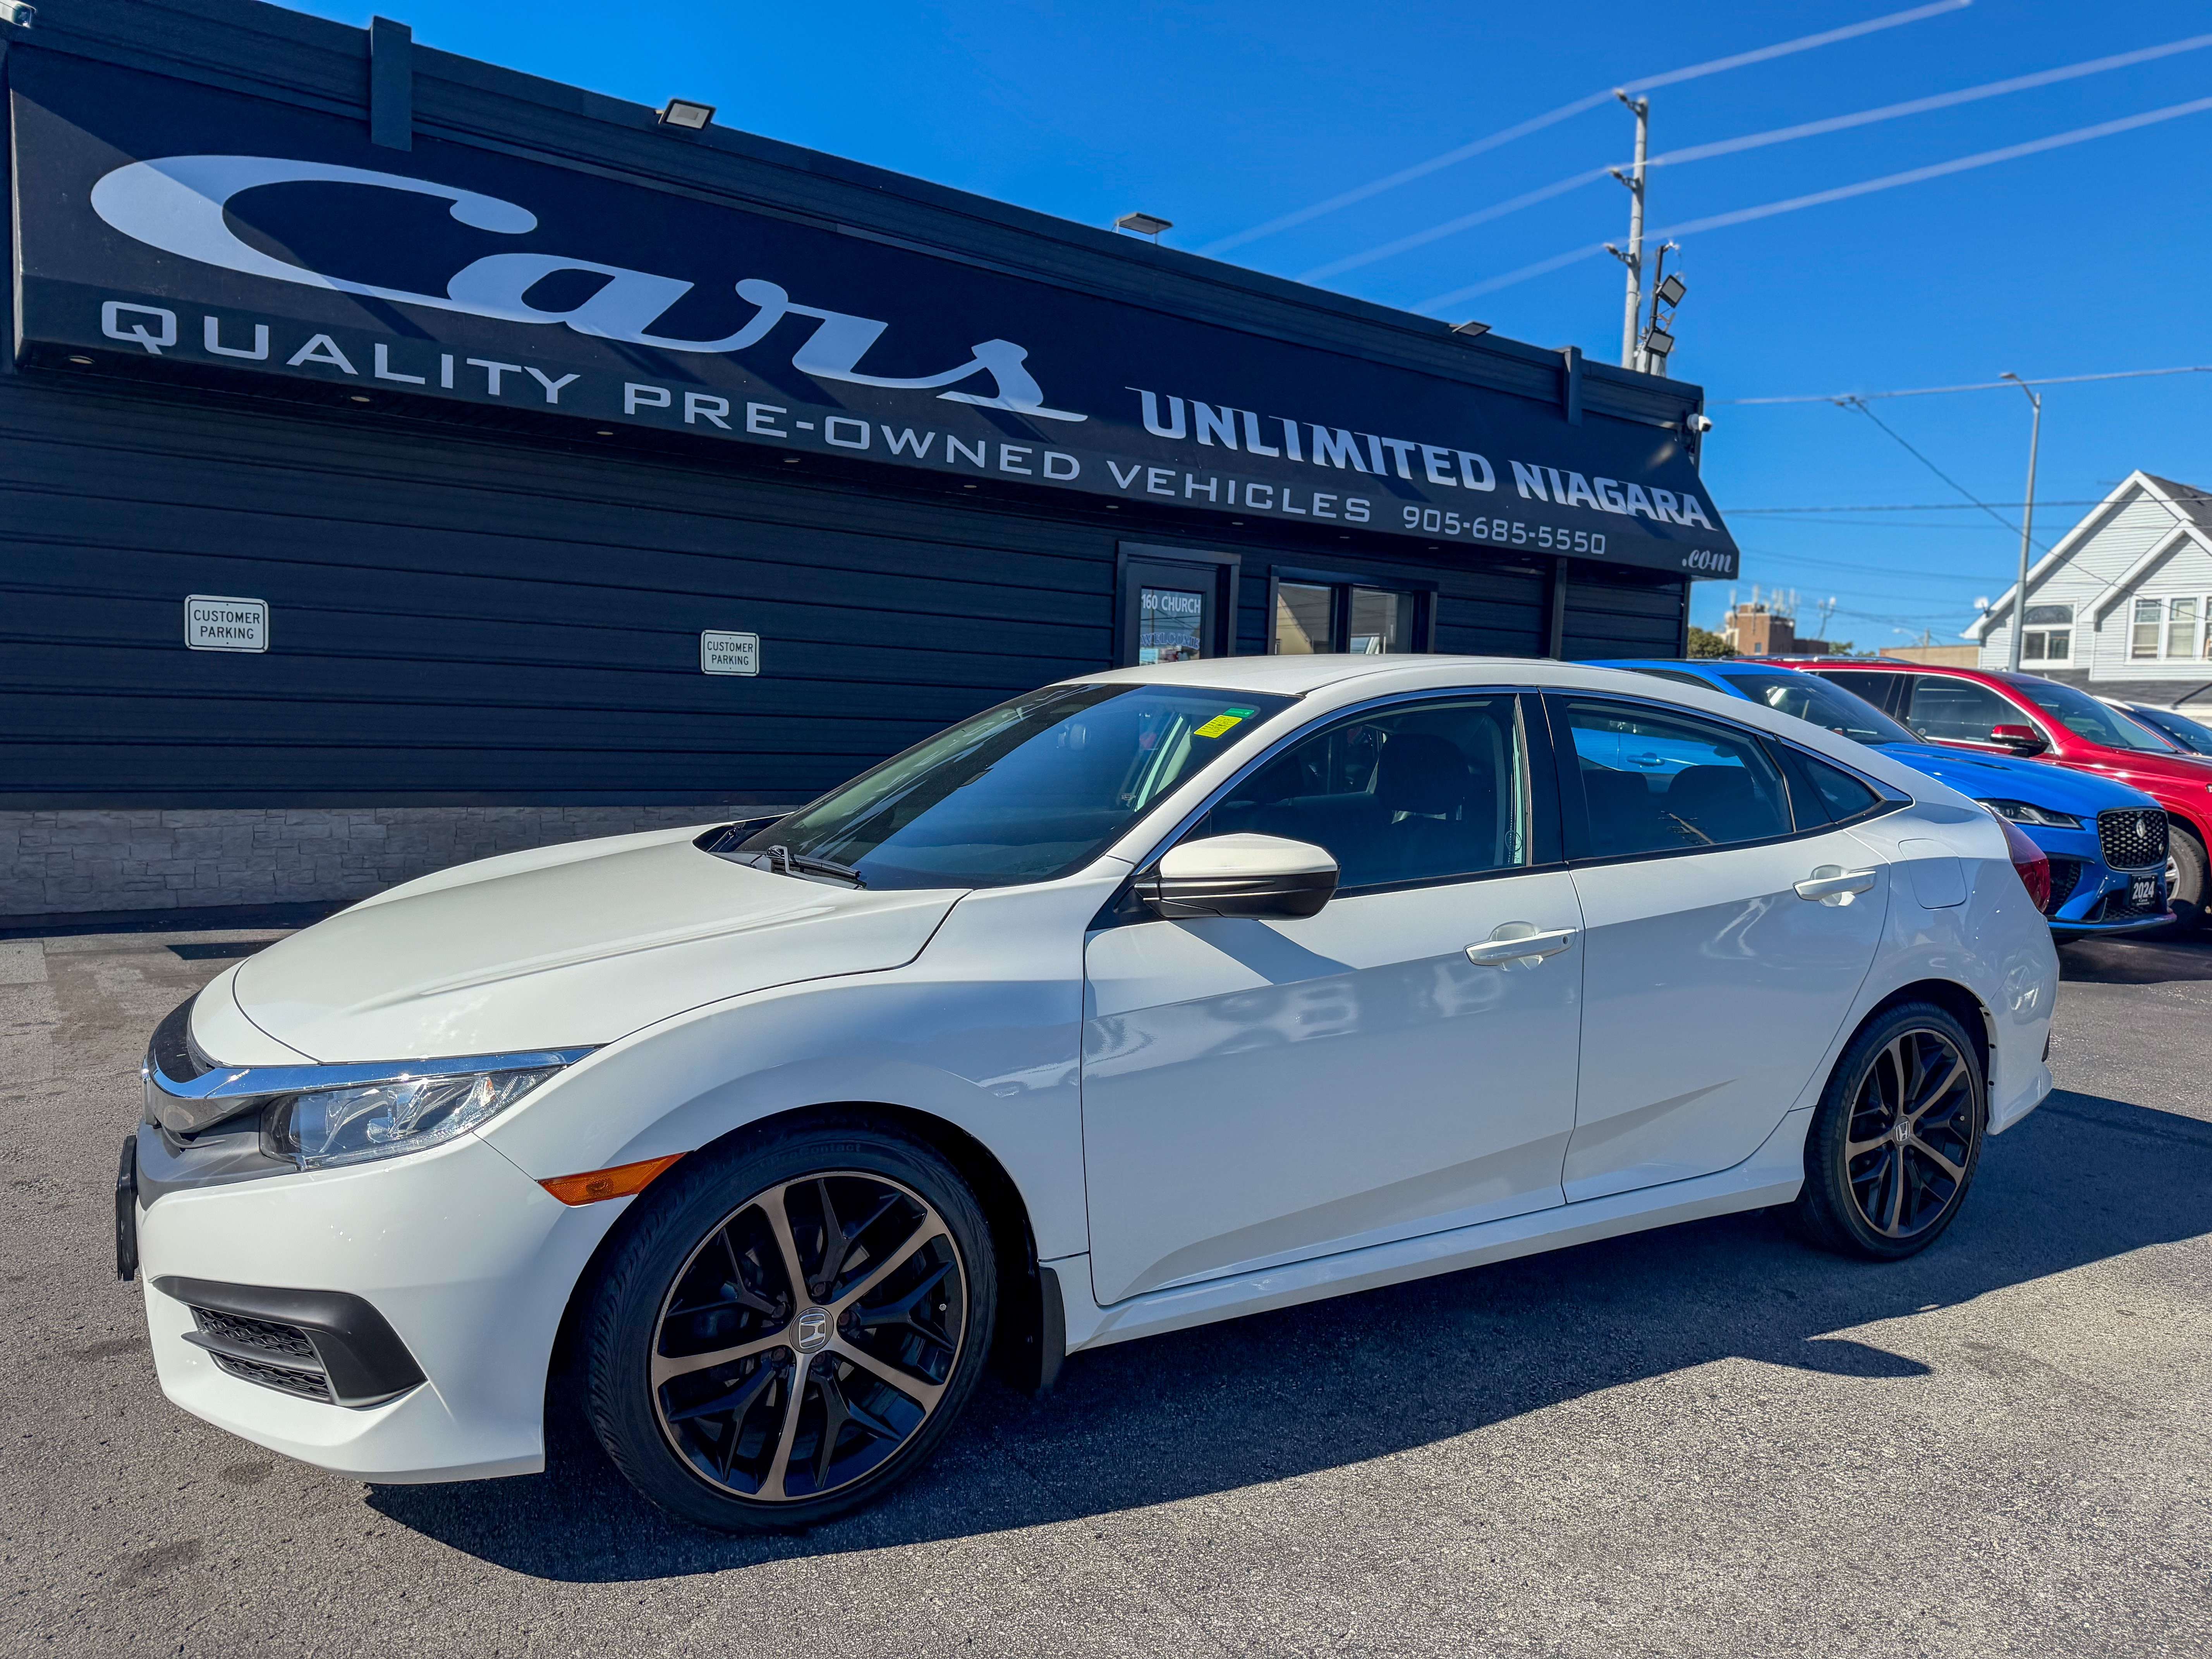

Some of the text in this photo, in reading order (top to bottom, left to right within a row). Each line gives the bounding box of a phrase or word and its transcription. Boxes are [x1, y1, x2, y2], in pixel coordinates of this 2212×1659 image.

[90, 155, 1088, 422] Cars
[101, 301, 1606, 555] QUALITY PRE-OWNED VEHICLES 905-685-5550
[1125, 387, 1718, 531] UNLIMITED NIAGARA
[1682, 550, 1733, 573] .com
[1141, 594, 1201, 613] 160 CHURCH
[194, 610, 260, 624] CUSTOMER
[200, 626, 254, 639] PARKING
[1140, 632, 1200, 650] WELCOME
[707, 641, 753, 653] CUSTOMER
[712, 654, 749, 665] PARKING
[2132, 881, 2155, 899] 2024
